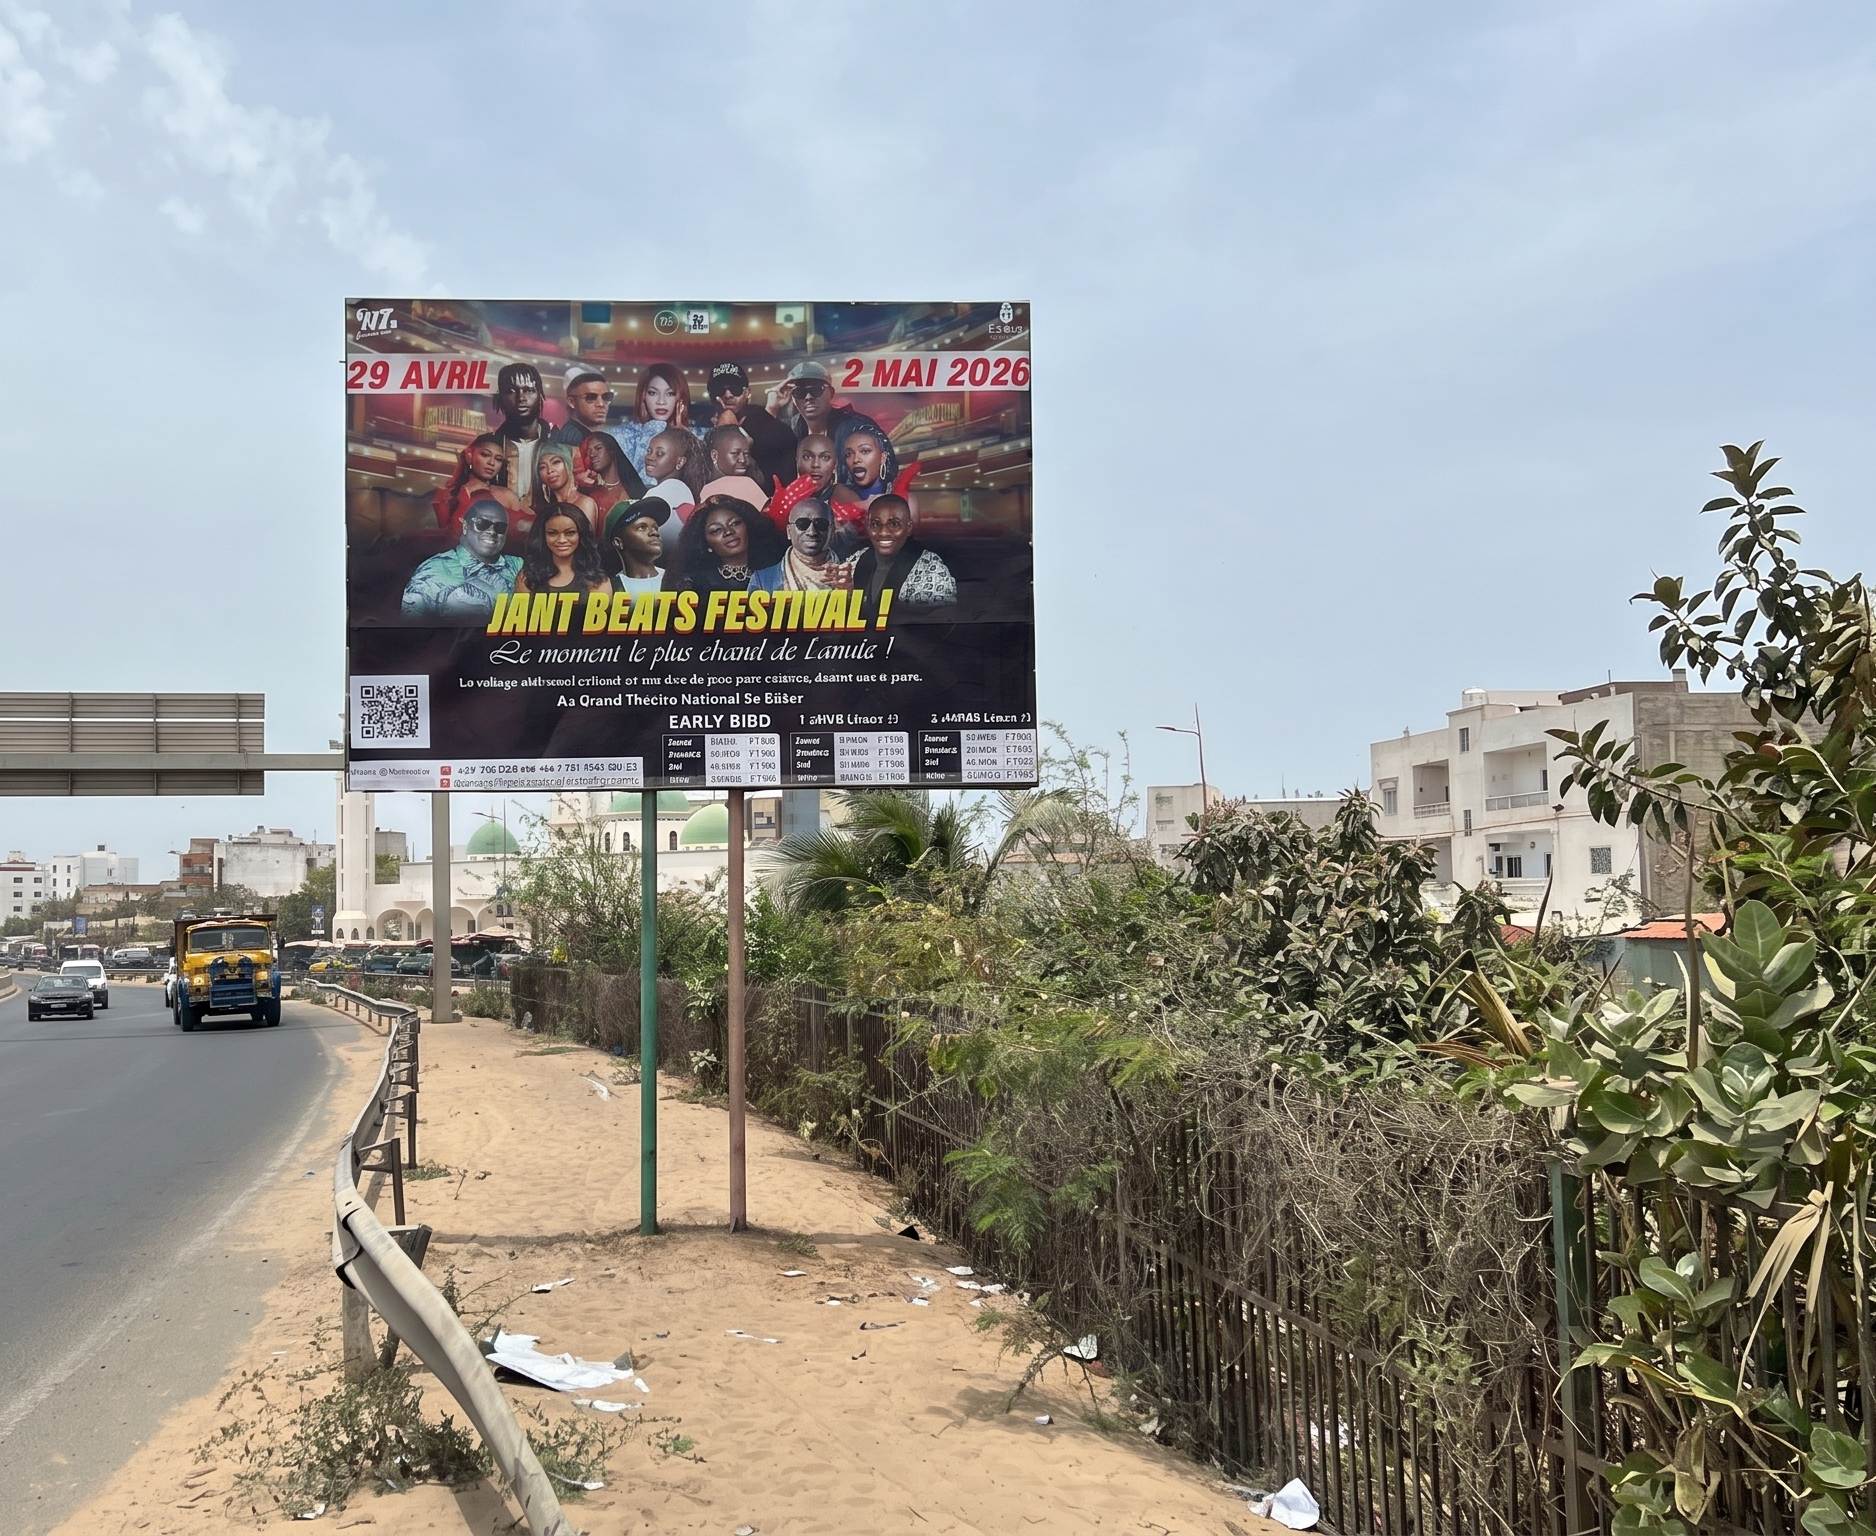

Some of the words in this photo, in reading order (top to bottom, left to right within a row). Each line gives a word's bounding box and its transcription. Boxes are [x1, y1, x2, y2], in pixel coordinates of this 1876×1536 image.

[346, 360, 390, 390] 29
[399, 360, 491, 390] AVRIL
[841, 358, 864, 388] 2
[871, 358, 938, 388] MAI
[946, 356, 1030, 388] 2026
[486, 592, 580, 636] JANT
[582, 590, 699, 636] BEATS
[703, 589, 868, 633] FESTIVAL
[875, 588, 895, 632] !
[489, 639, 533, 665] Le
[537, 645, 623, 664] moment
[628, 639, 648, 663] le
[649, 639, 694, 671] plus
[770, 637, 798, 662] de
[681, 692, 740, 705] National
[744, 692, 761, 705] Se
[669, 714, 725, 729] EARLY
[729, 713, 771, 728] BIBD
